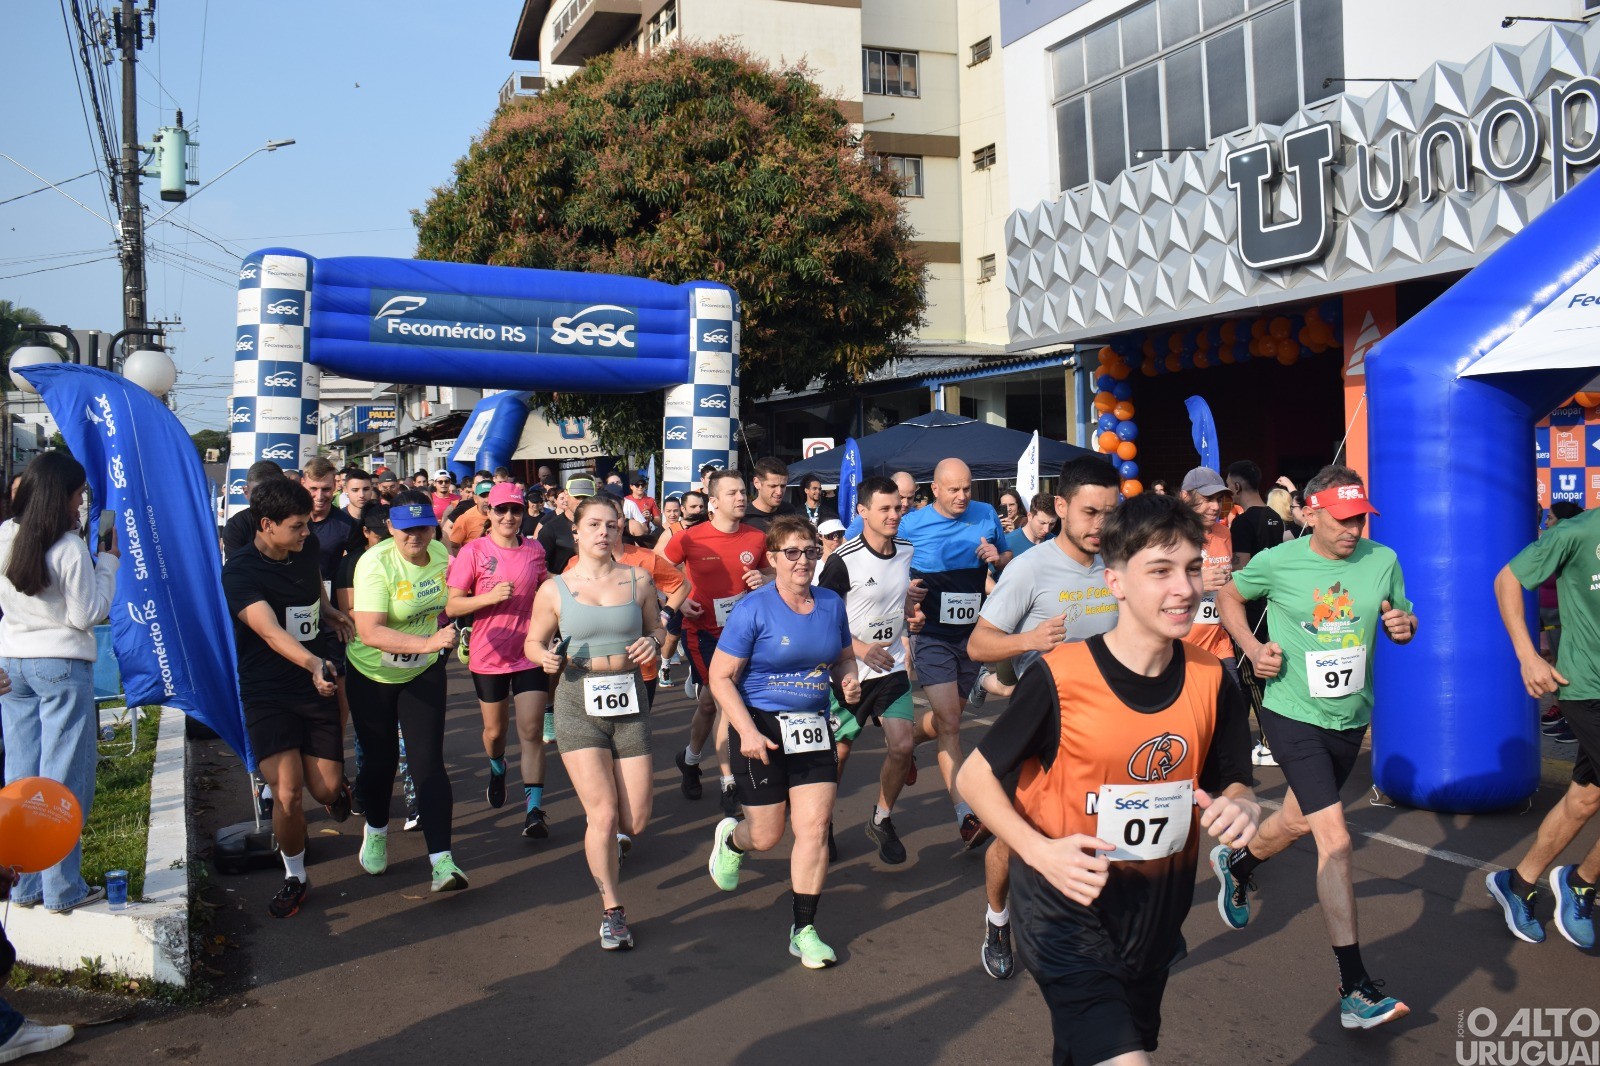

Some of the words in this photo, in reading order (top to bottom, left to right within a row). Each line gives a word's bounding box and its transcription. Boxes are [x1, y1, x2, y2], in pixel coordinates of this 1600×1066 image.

[388, 318, 496, 341] Fecomércio
[501, 325, 526, 343] RS
[551, 313, 635, 347] Sesc
[666, 430, 688, 441] Sesc
[1552, 491, 1583, 502] unopar
[124, 508, 148, 581] Sindicatos
[157, 545, 168, 580] Sistema
[417, 585, 441, 598] CORRER
[143, 600, 157, 621] RS
[947, 607, 975, 619] 100
[872, 627, 893, 640] 48
[150, 622, 177, 697] Fecomércio
[1315, 658, 1339, 667] Sesc
[1325, 668, 1353, 689] 97
[593, 692, 630, 710] 160
[790, 727, 823, 745] 198
[1114, 797, 1150, 810] Sesc
[1123, 816, 1169, 846] 07
